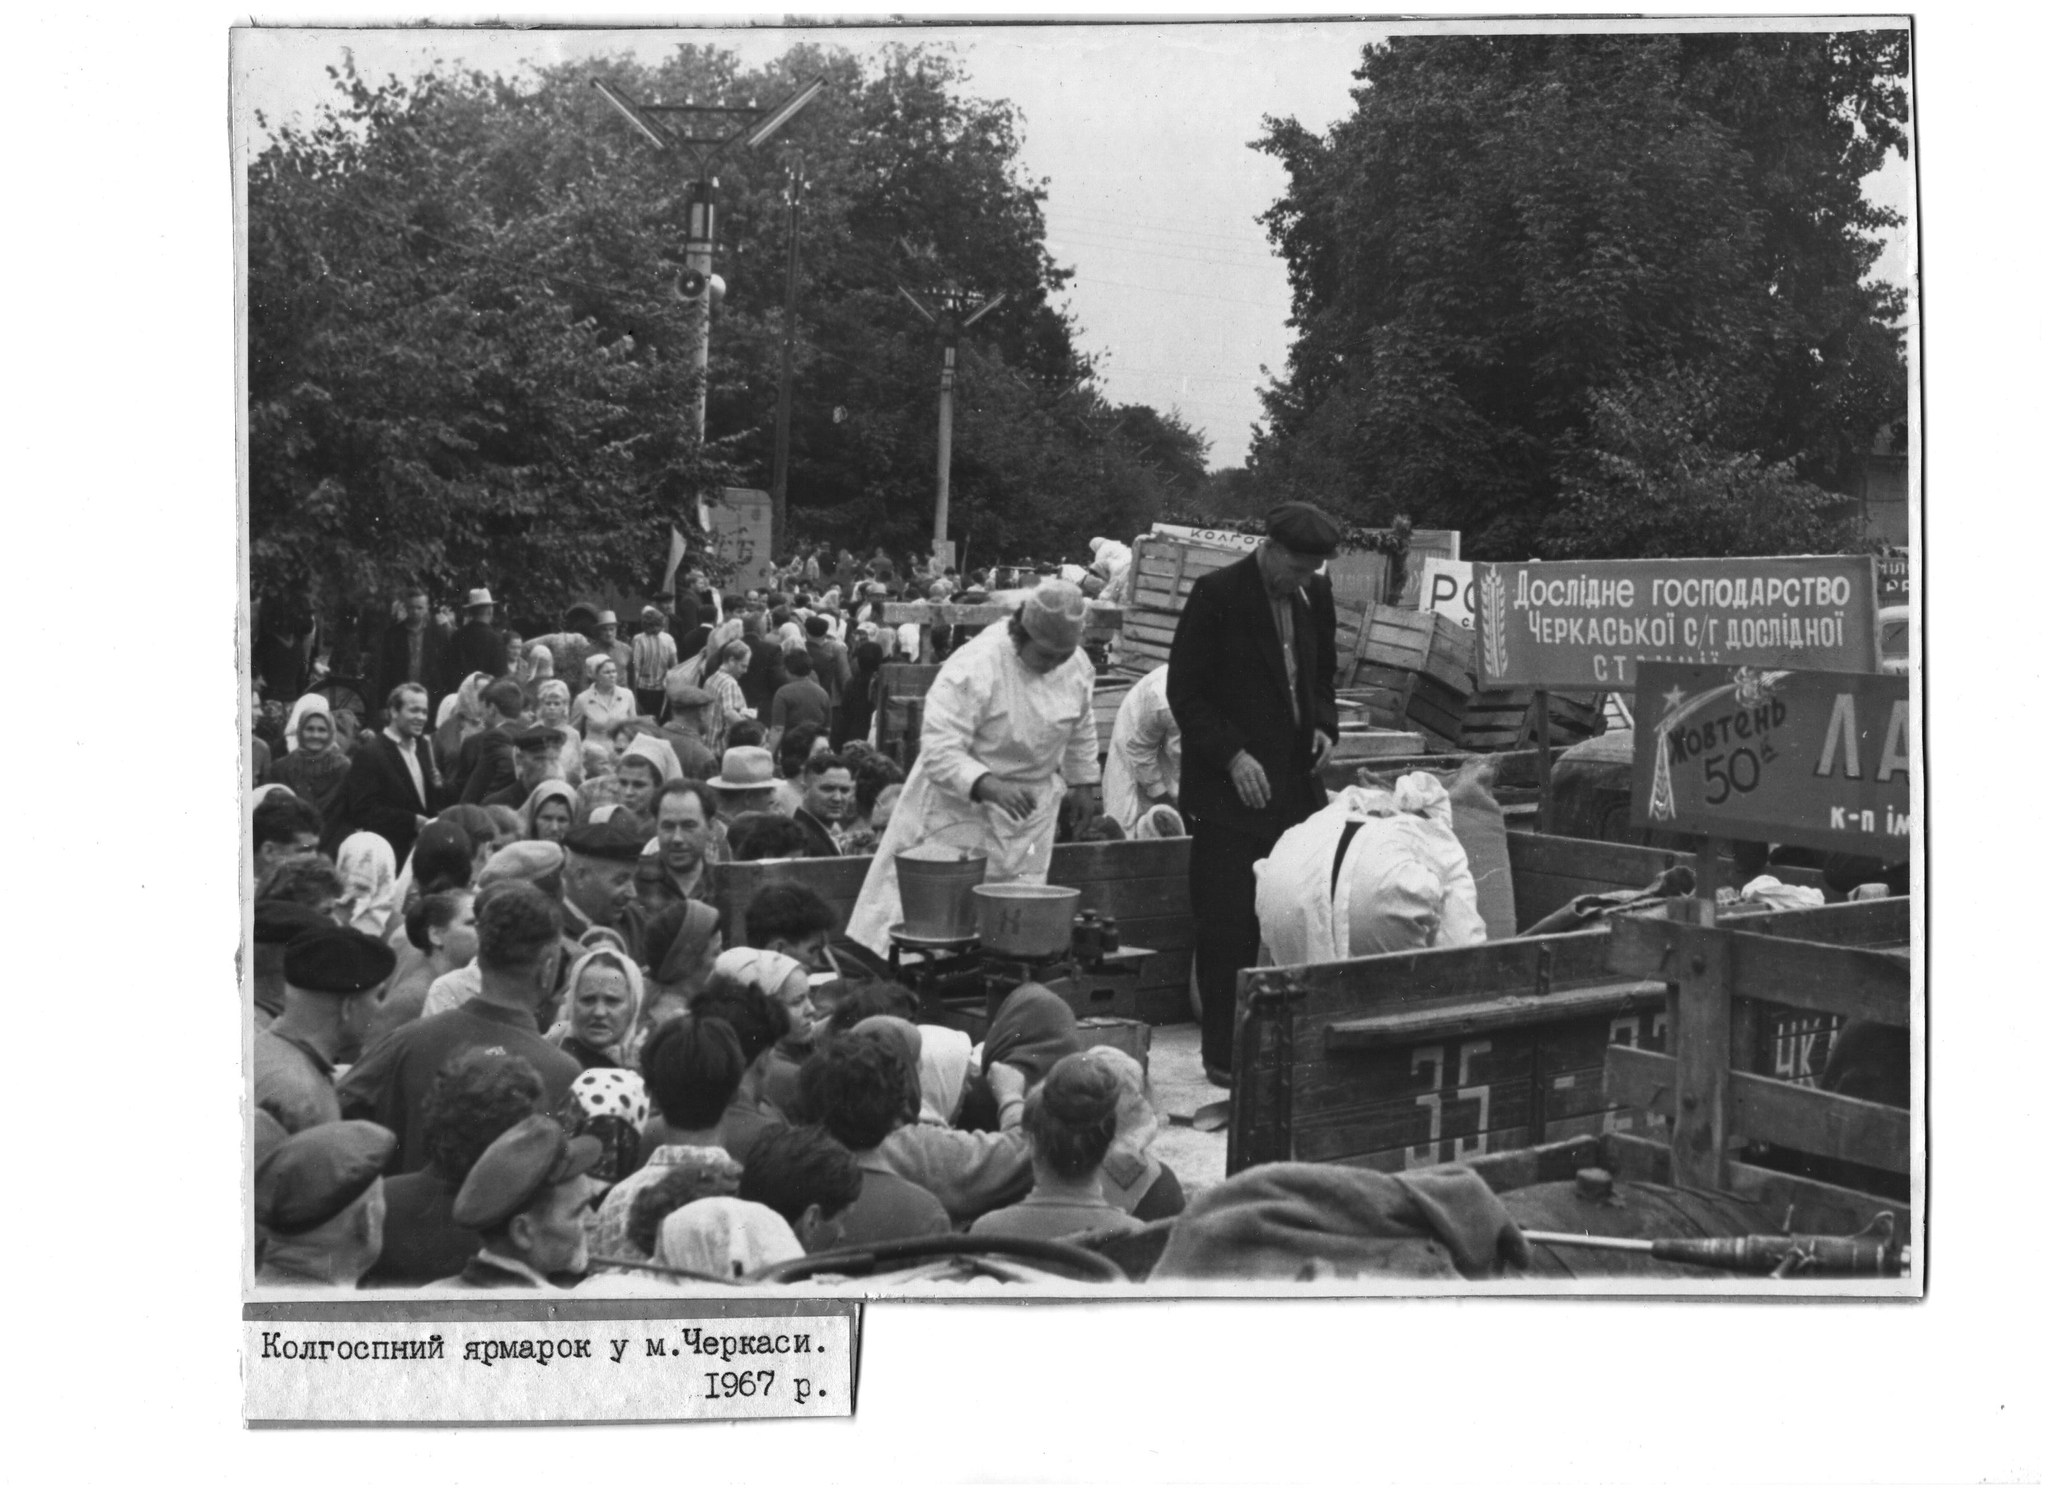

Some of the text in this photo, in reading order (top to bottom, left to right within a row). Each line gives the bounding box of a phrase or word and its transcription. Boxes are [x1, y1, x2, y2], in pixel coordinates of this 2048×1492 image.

[1513, 570, 1634, 609] Дослідне
[261, 1331, 445, 1360] Колгоспний
[463, 1339, 592, 1367] ярмарок
[610, 1338, 630, 1363] у
[793, 1376, 827, 1404] р.
